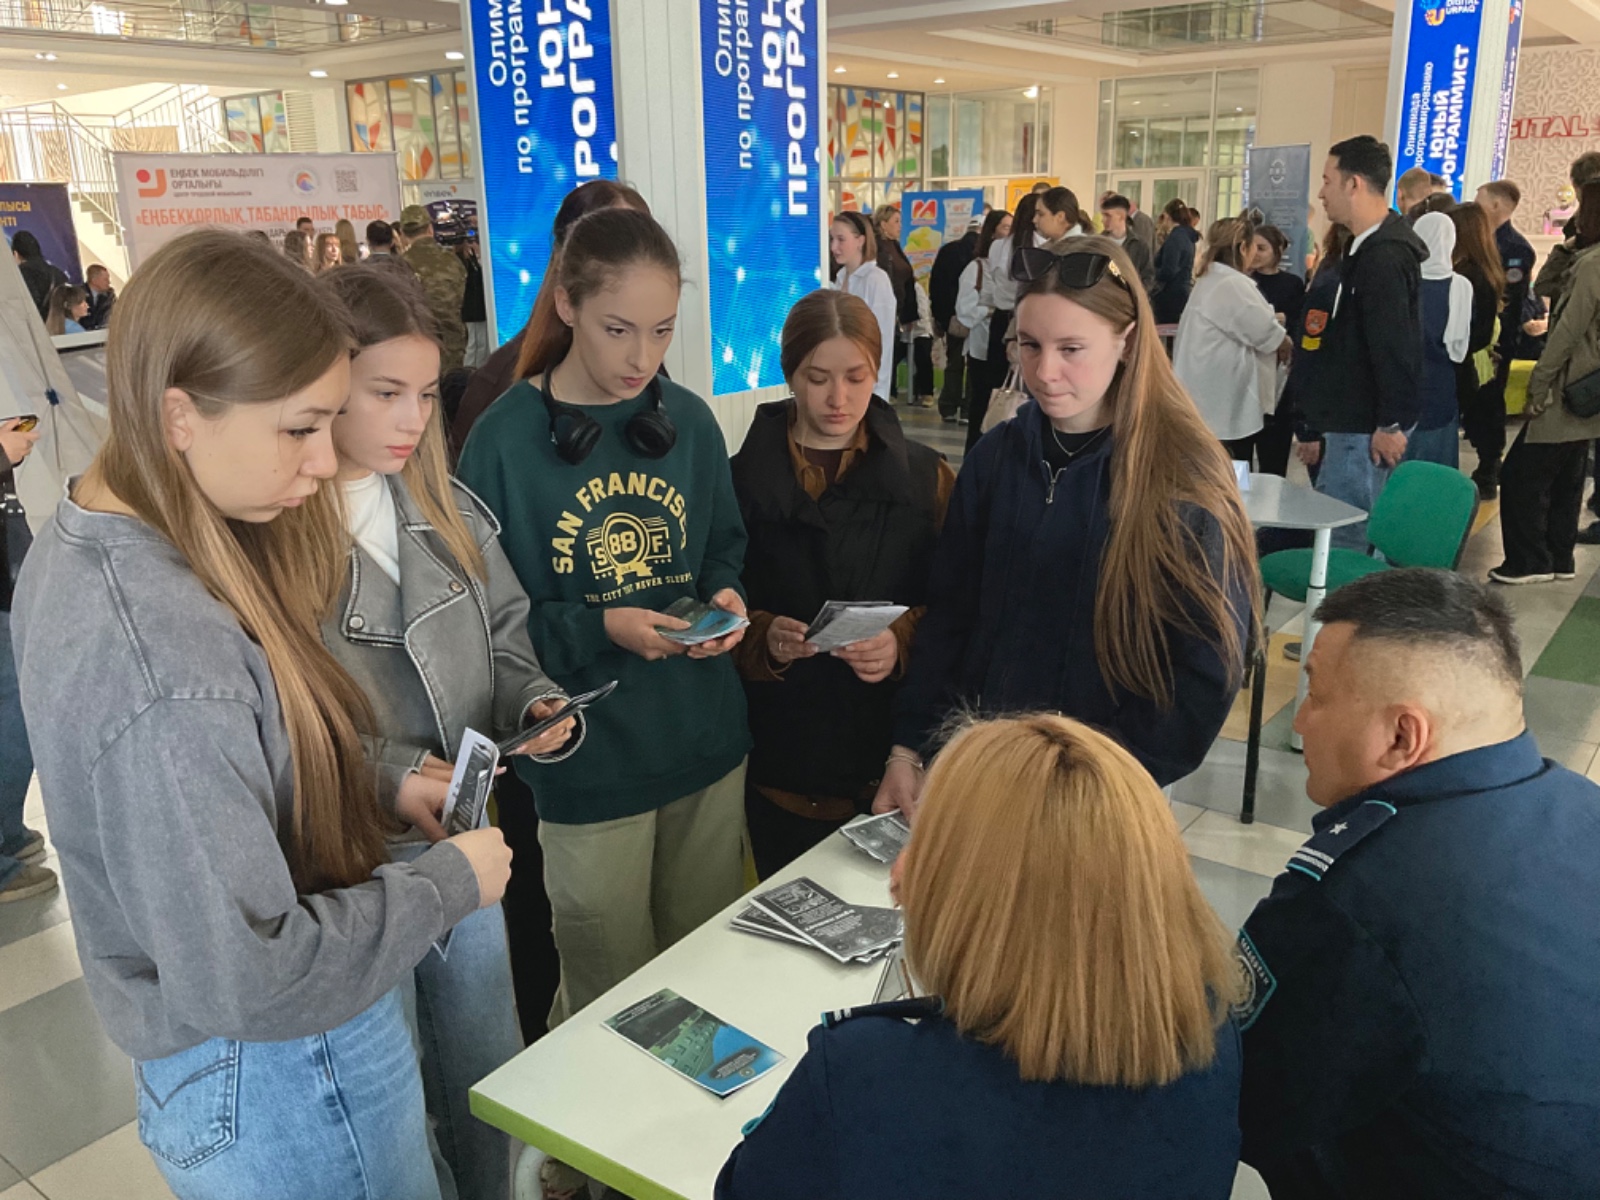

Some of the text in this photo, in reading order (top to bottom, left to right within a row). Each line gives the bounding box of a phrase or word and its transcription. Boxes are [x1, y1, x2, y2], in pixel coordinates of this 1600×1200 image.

[715, 0, 733, 77] Оли
[738, 131, 753, 169] по
[1404, 92, 1422, 157] Олимпиада
[1429, 90, 1450, 158] ЮНЫЙ
[1442, 44, 1470, 193] РОГРАММИСТ
[517, 136, 534, 174] по
[552, 510, 584, 574] SAN
[608, 531, 637, 555] 88
[651, 535, 663, 553] F
[602, 589, 622, 602] CITY
[635, 577, 663, 590] NEVER
